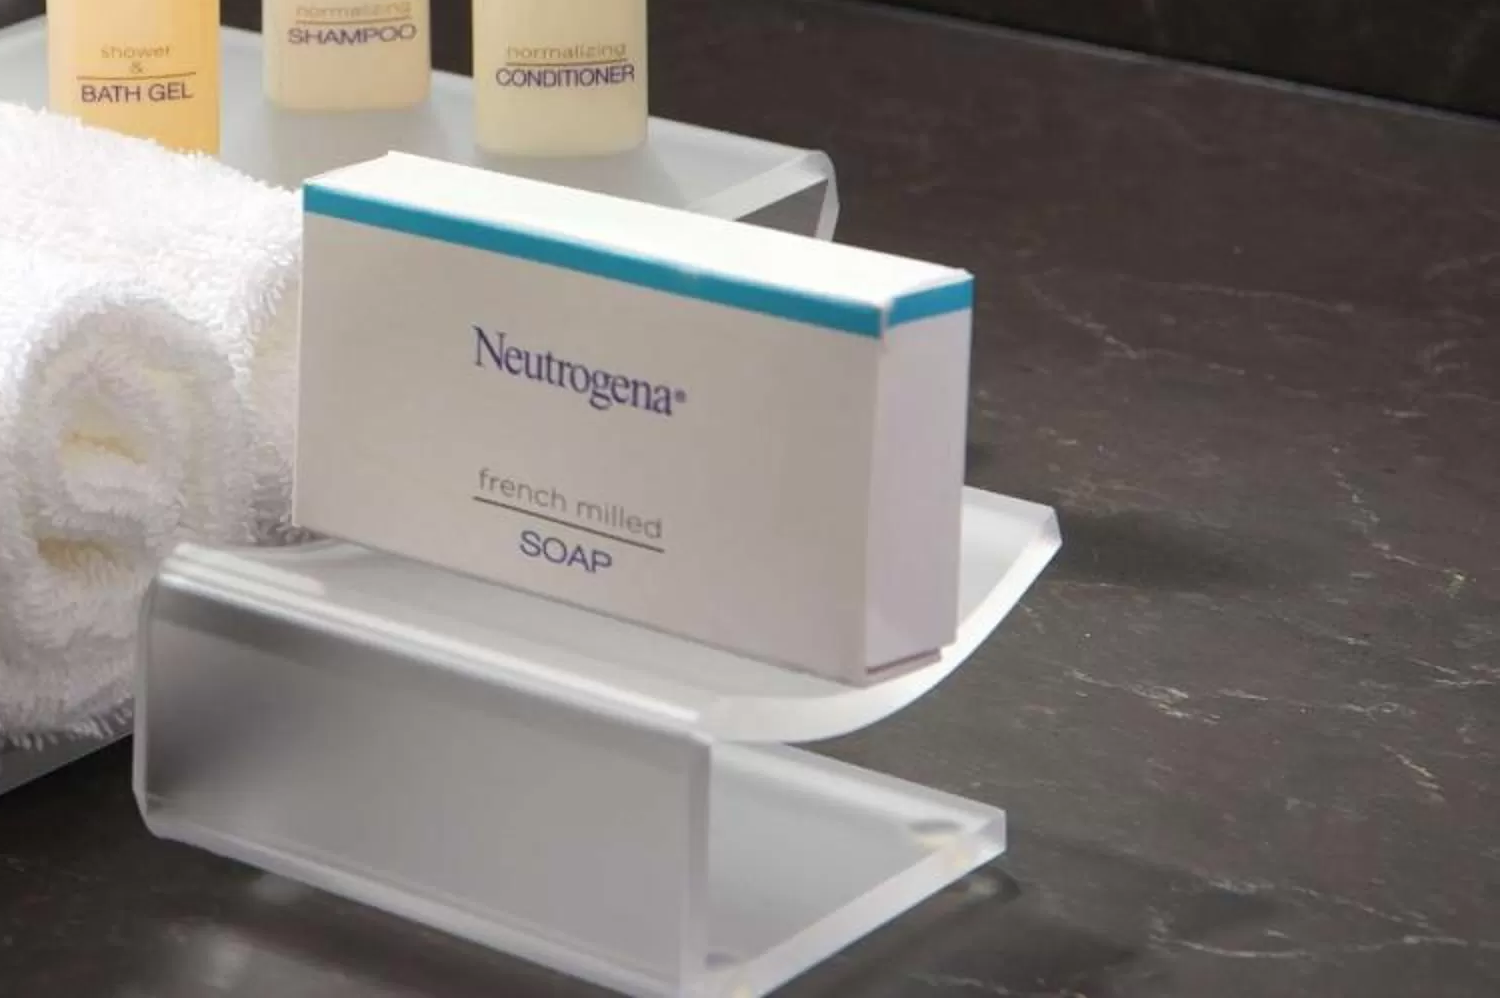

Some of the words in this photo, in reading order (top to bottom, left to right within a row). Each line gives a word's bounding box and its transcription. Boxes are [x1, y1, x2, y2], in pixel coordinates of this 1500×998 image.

[287, 23, 418, 46] SHAMPOO
[496, 63, 635, 88] CONDITIONER
[81, 84, 141, 103] BATH
[147, 81, 194, 102] GEL
[478, 467, 567, 513] french
[576, 499, 663, 540] milled
[519, 529, 613, 574] SOAP
